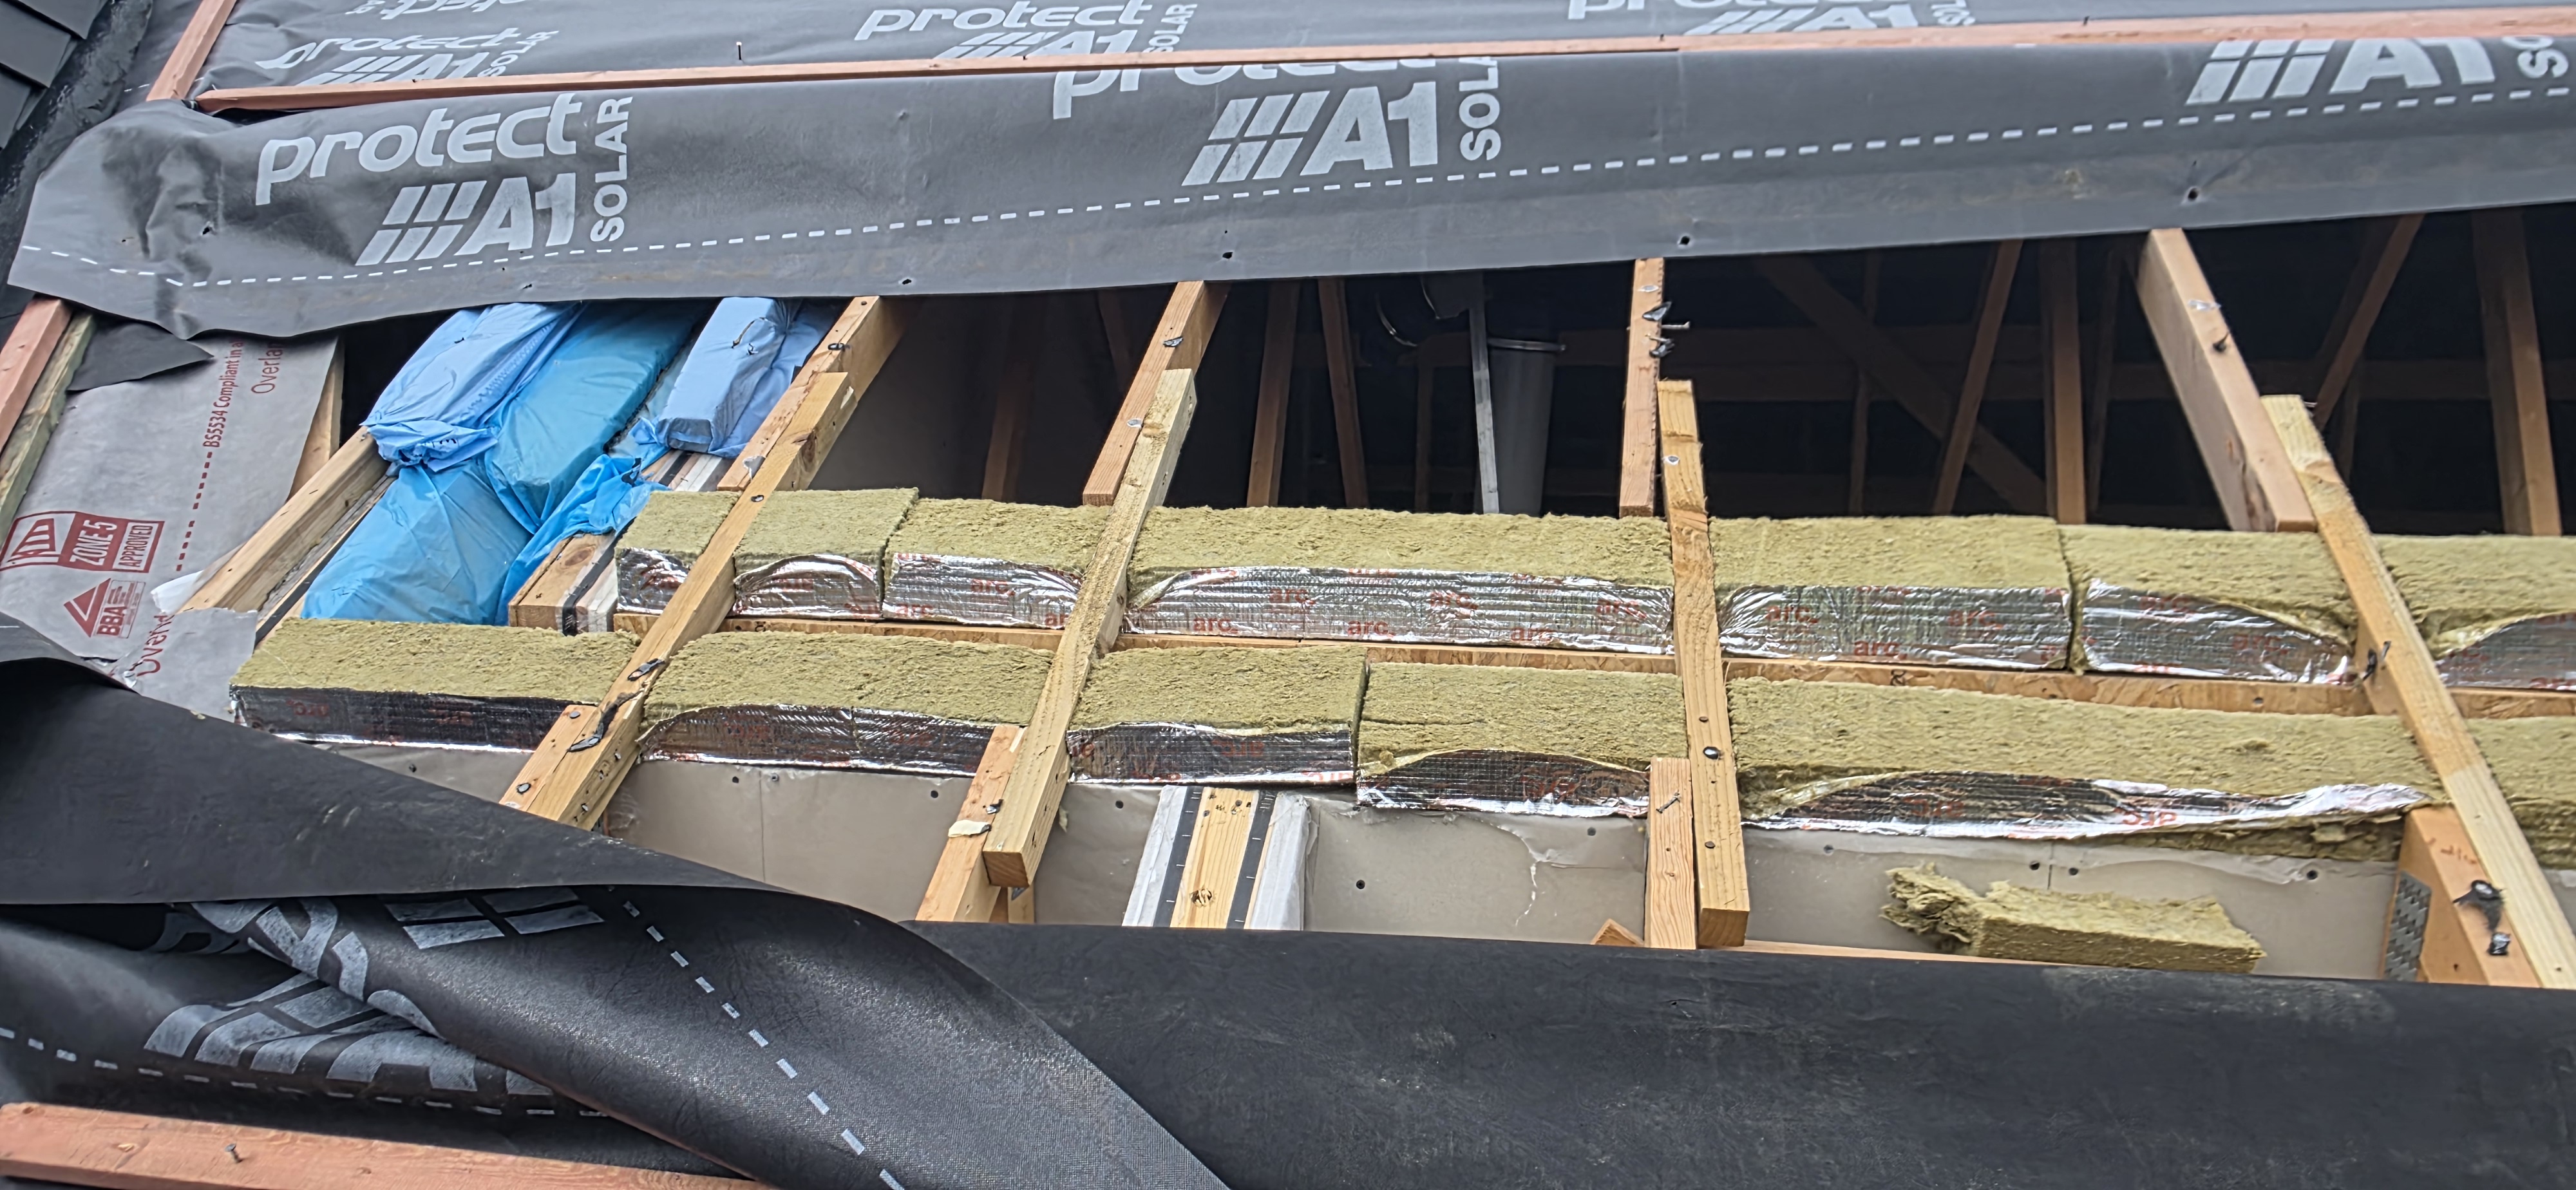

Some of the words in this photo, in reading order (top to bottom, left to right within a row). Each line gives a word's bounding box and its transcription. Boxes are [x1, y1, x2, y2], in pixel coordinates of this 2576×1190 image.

[855, 0, 1151, 40] protect
[254, 27, 521, 69] protect
[1300, 81, 1439, 176] A1
[1458, 55, 1502, 161] SOL
[256, 92, 583, 207] protect
[589, 95, 634, 243] SOLAR
[454, 172, 577, 256] A1
[213, 359, 240, 408] Compliant
[202, 409, 228, 448] BS5534
[82, 519, 118, 531] 5
[117, 524, 154, 568] APPROVED
[69, 529, 114, 566] ZONE
[96, 605, 128, 637] BBA
